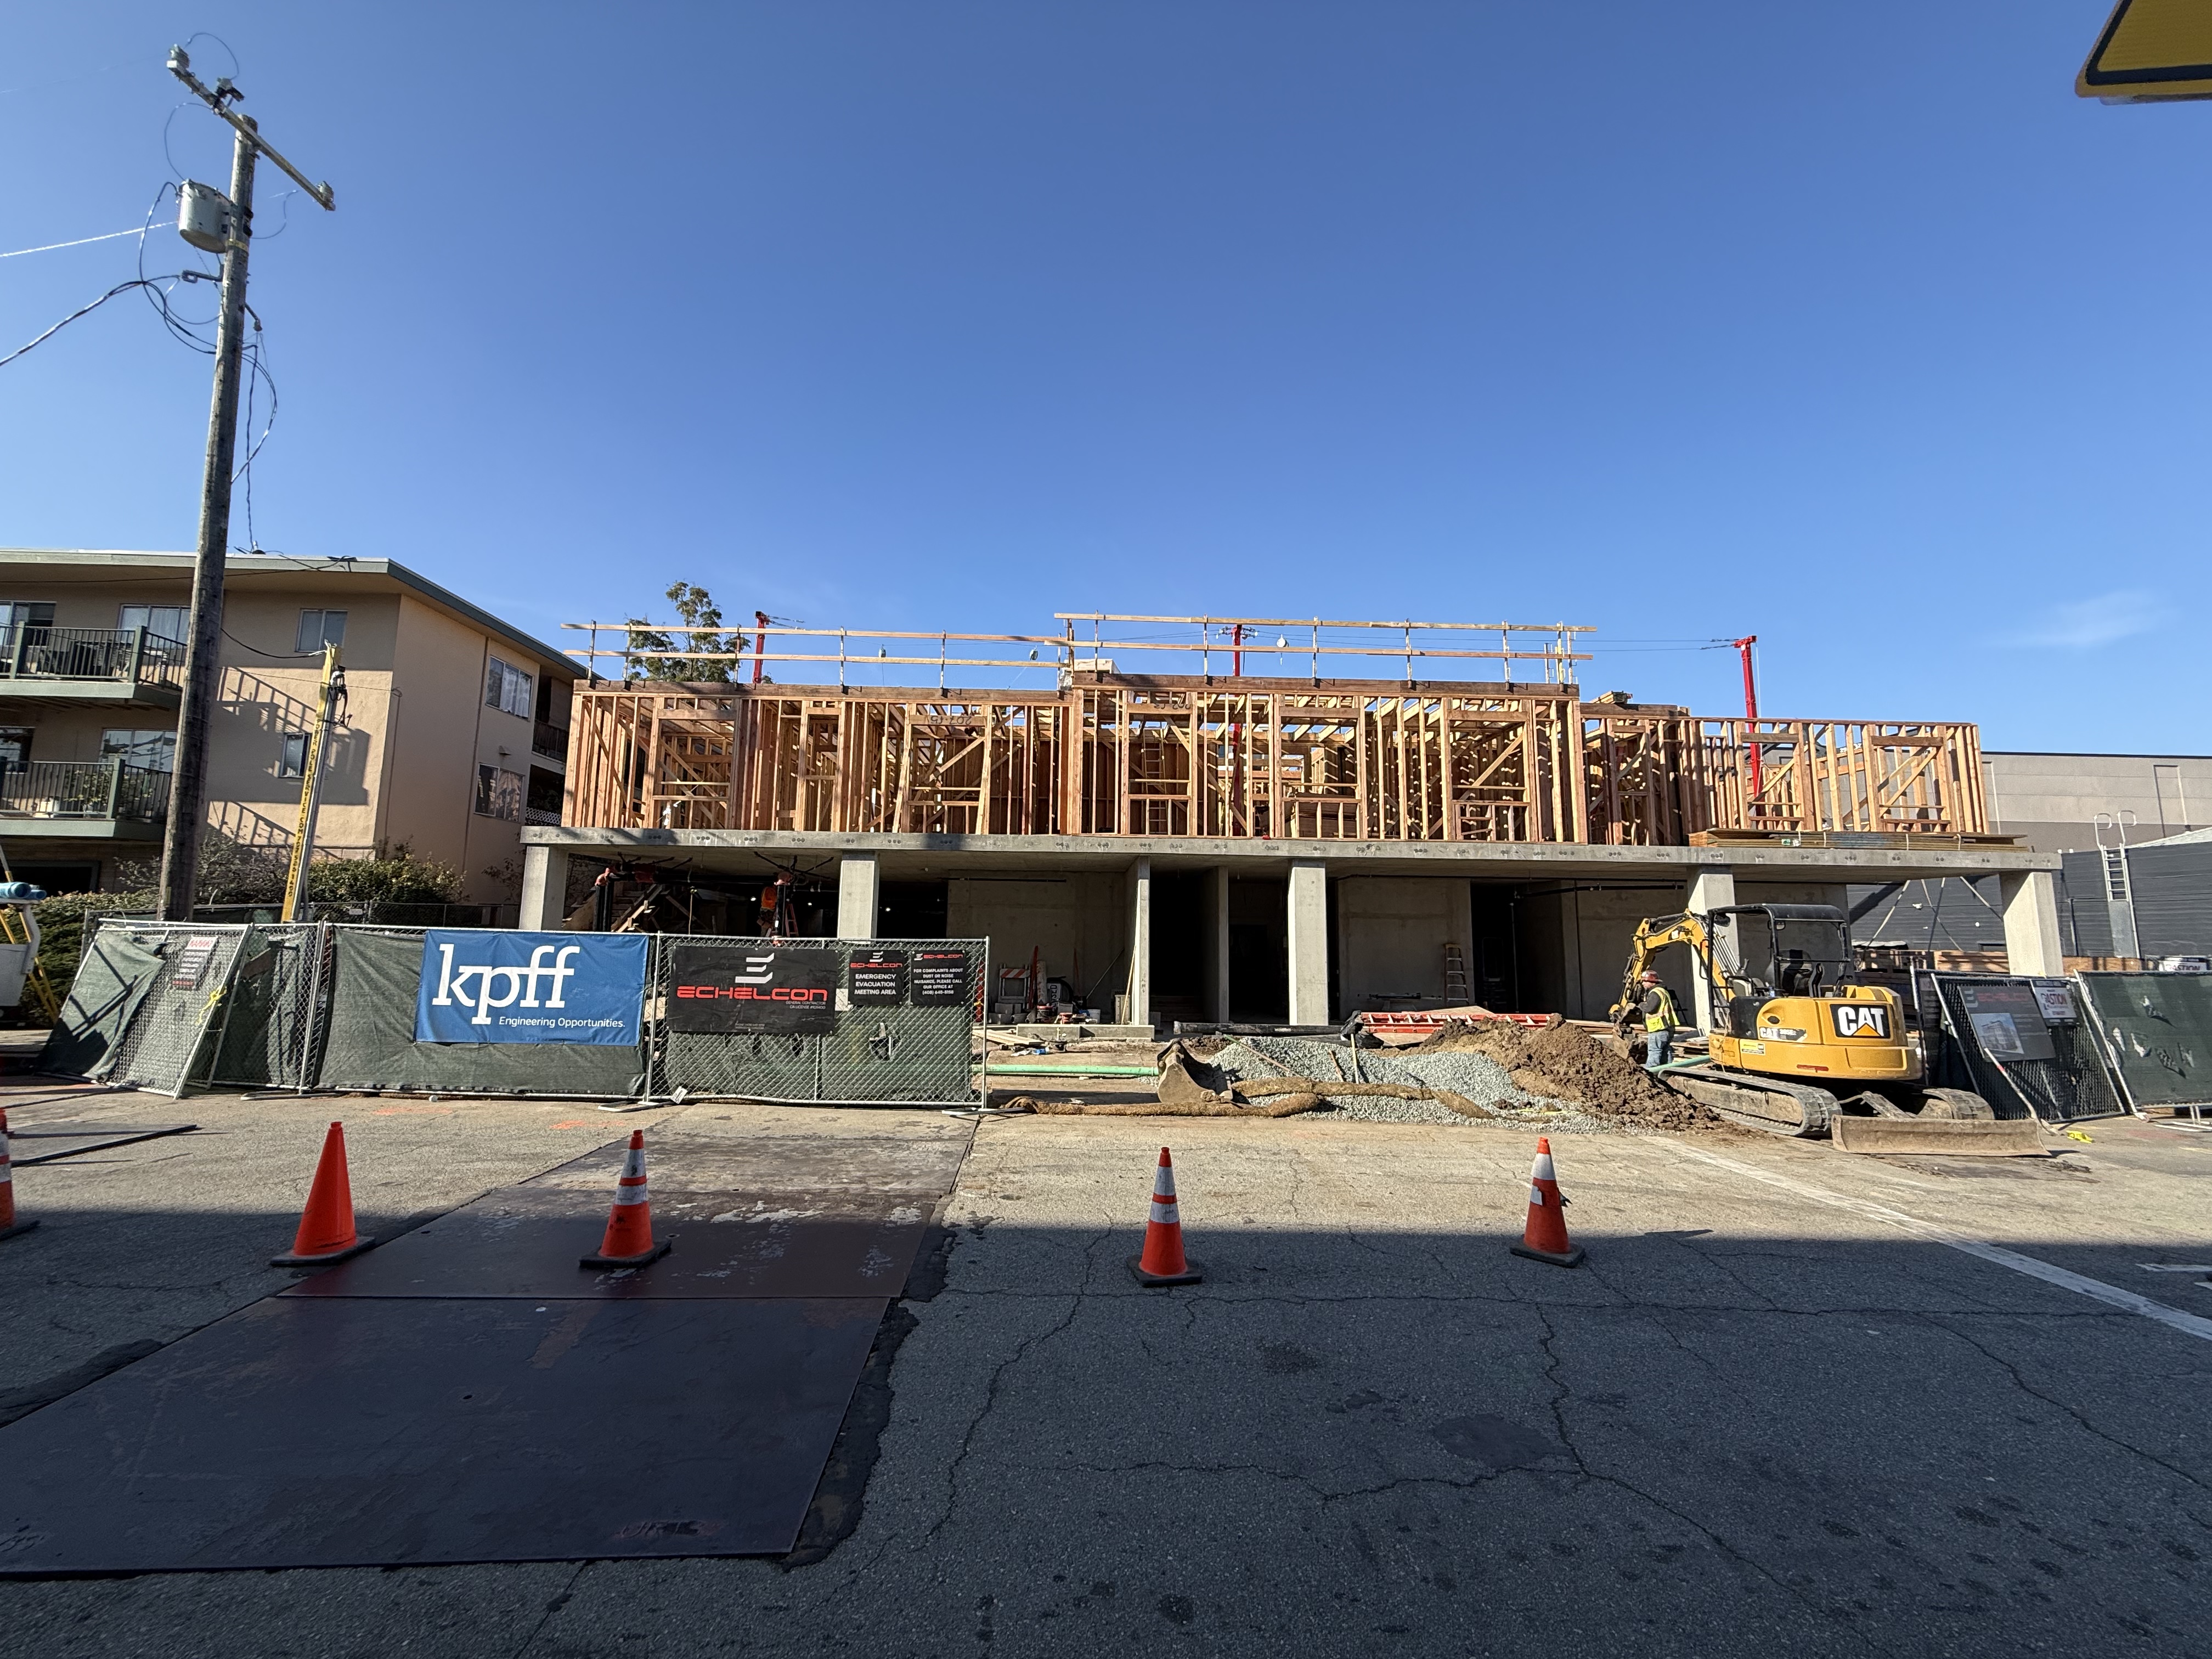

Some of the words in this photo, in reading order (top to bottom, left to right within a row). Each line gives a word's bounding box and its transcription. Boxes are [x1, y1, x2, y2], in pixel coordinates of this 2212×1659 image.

[432, 944, 580, 1025] kpff
[677, 986, 828, 1001] ECHELCON
[499, 1016, 556, 1029] Engineering
[557, 1017, 626, 1029] Opportunities.
[1838, 1006, 1884, 1036] CAT
[1759, 1027, 1778, 1039] CAT
